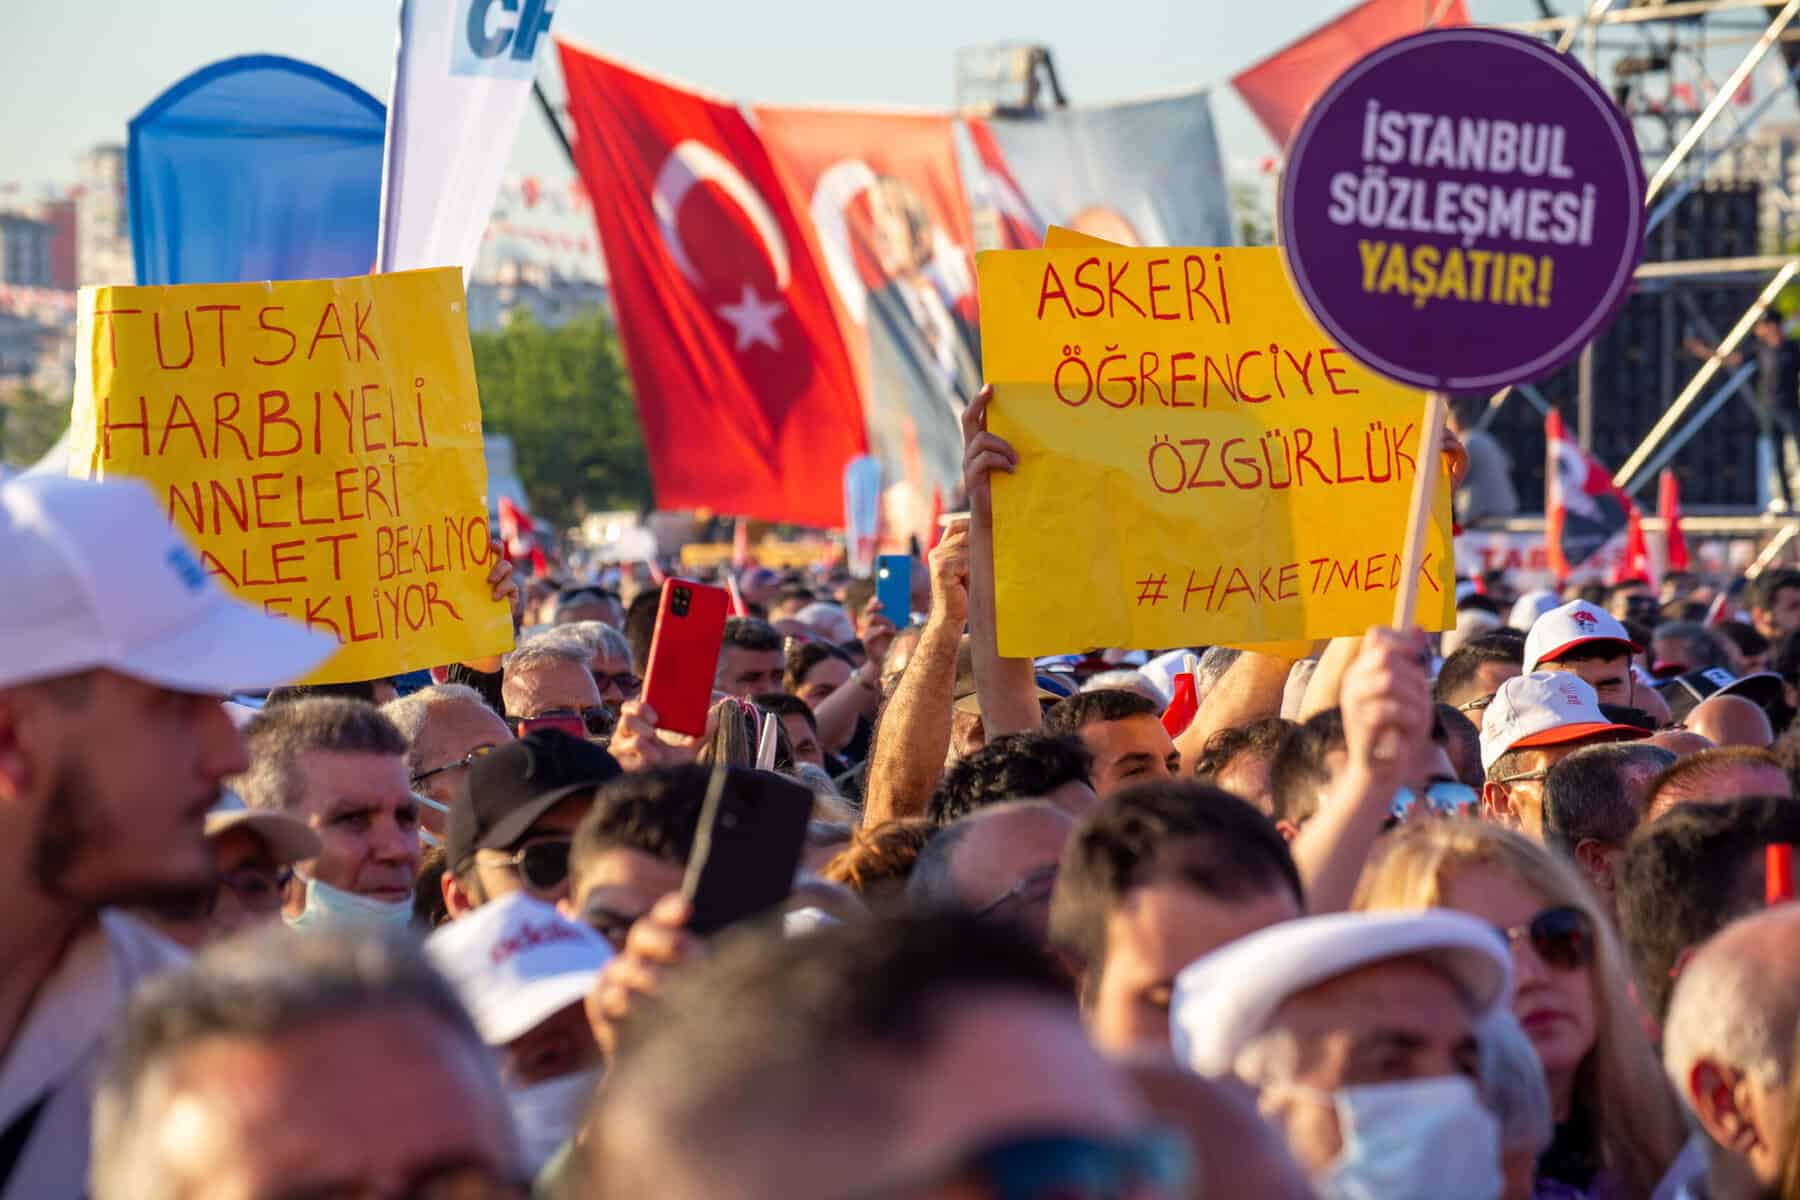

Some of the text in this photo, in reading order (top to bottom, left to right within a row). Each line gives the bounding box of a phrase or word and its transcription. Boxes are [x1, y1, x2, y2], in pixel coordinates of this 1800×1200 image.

[1361, 98, 1575, 179] İSTANBUL
[1327, 164, 1597, 247] SÖZLEŞMESİ
[1037, 252, 1231, 325] ASKERİ
[1358, 239, 1555, 309] YAŞATIR!
[92, 302, 380, 370] TUTSAK
[1053, 343, 1360, 409] ÖĞRENCİYE
[1147, 420, 1418, 494] ÖZGÜRLÜK
[167, 454, 401, 536] NNELERİ
[200, 515, 494, 590] ALET BEKLİYO
[263, 581, 465, 645] EKLİYOR
